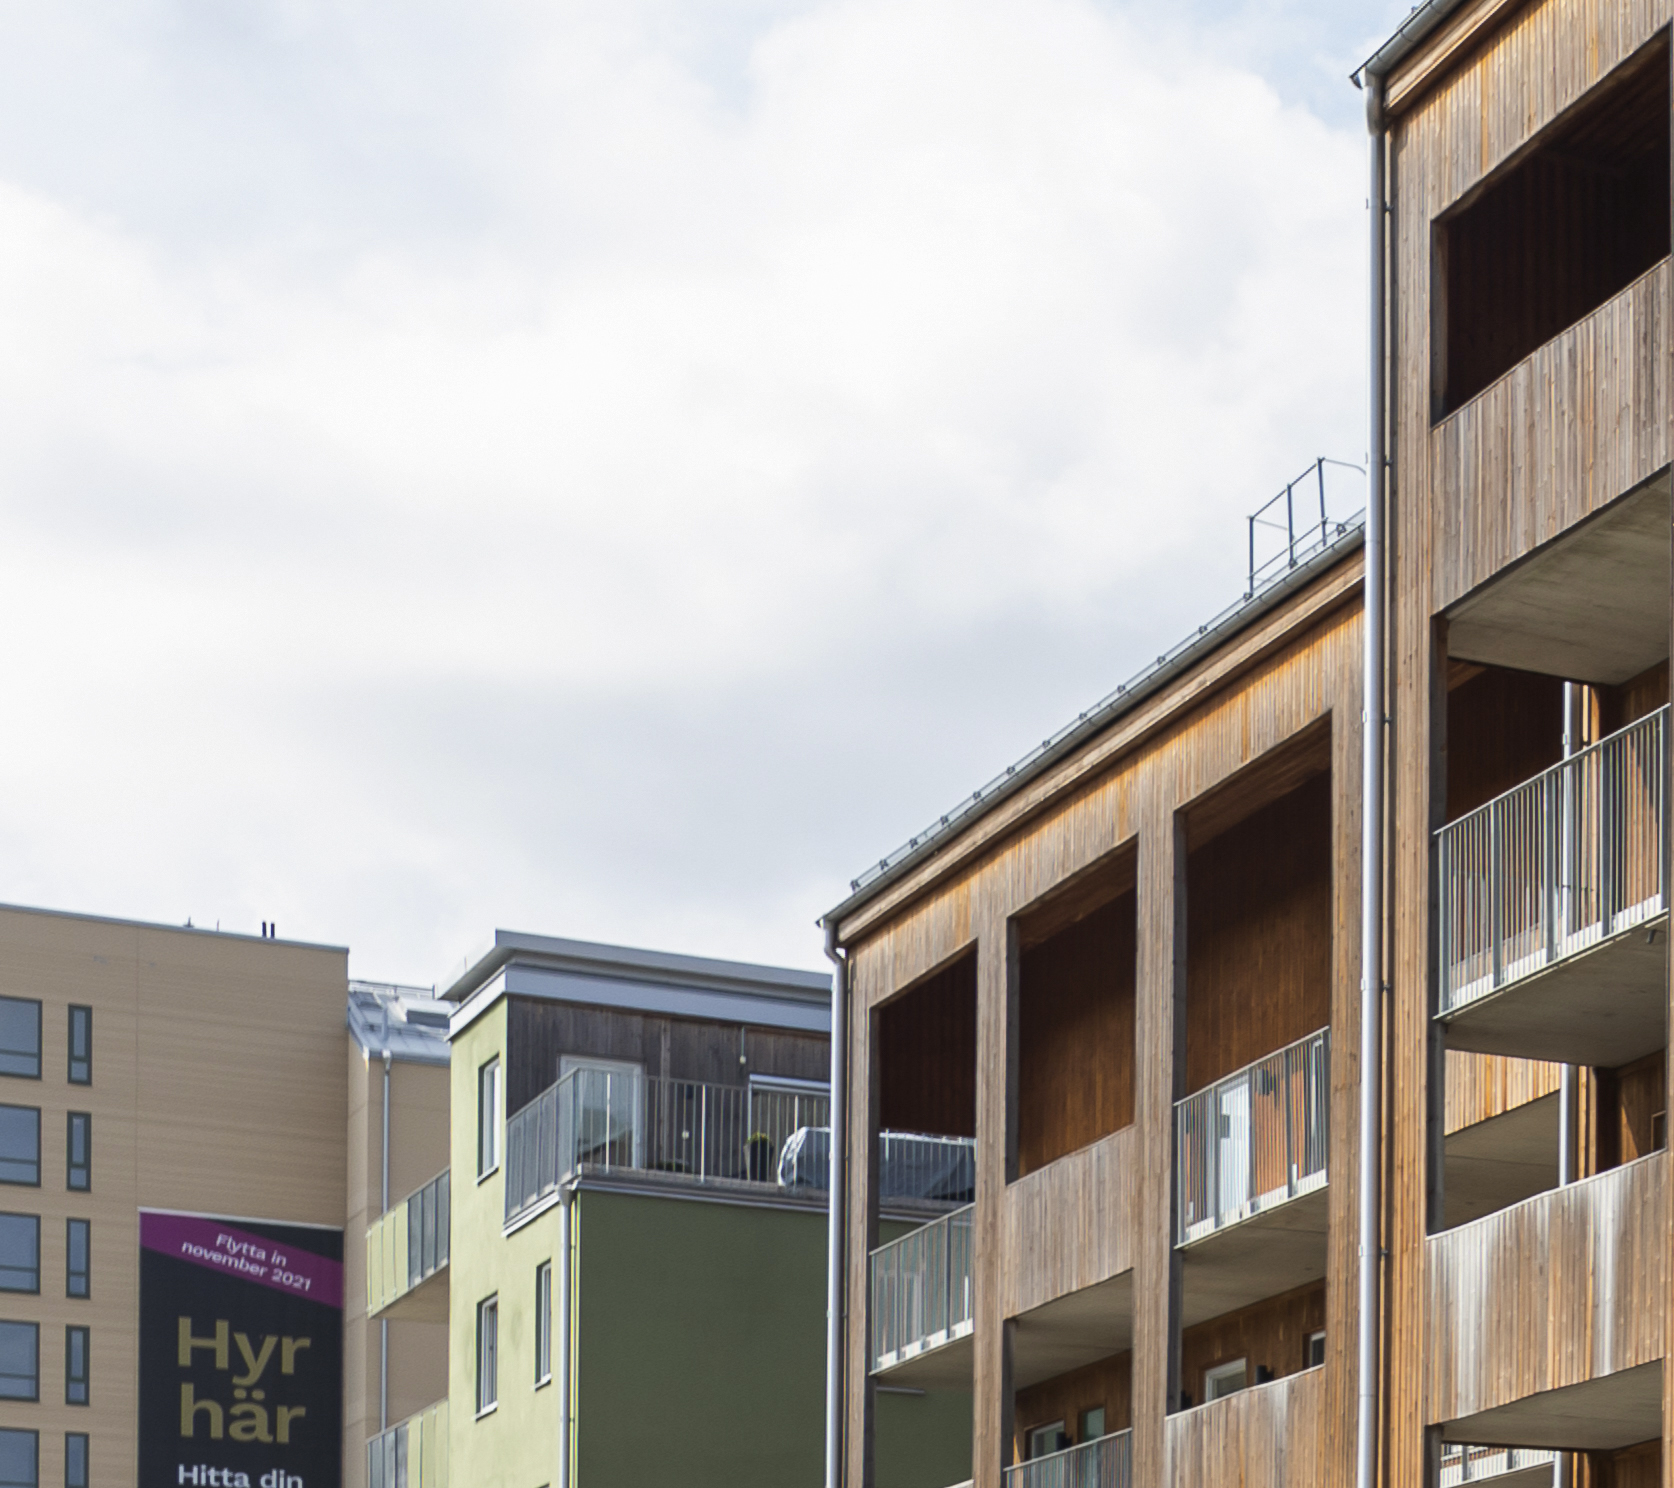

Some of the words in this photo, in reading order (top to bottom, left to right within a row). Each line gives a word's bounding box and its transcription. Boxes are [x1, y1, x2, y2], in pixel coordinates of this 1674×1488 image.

[182, 1241, 268, 1277] november
[271, 1268, 311, 1291] 2021
[216, 1233, 266, 1261] Flytta
[271, 1250, 287, 1267] in
[178, 1316, 311, 1387] Hyr
[180, 1382, 306, 1444] här
[178, 1464, 250, 1488] Hitta
